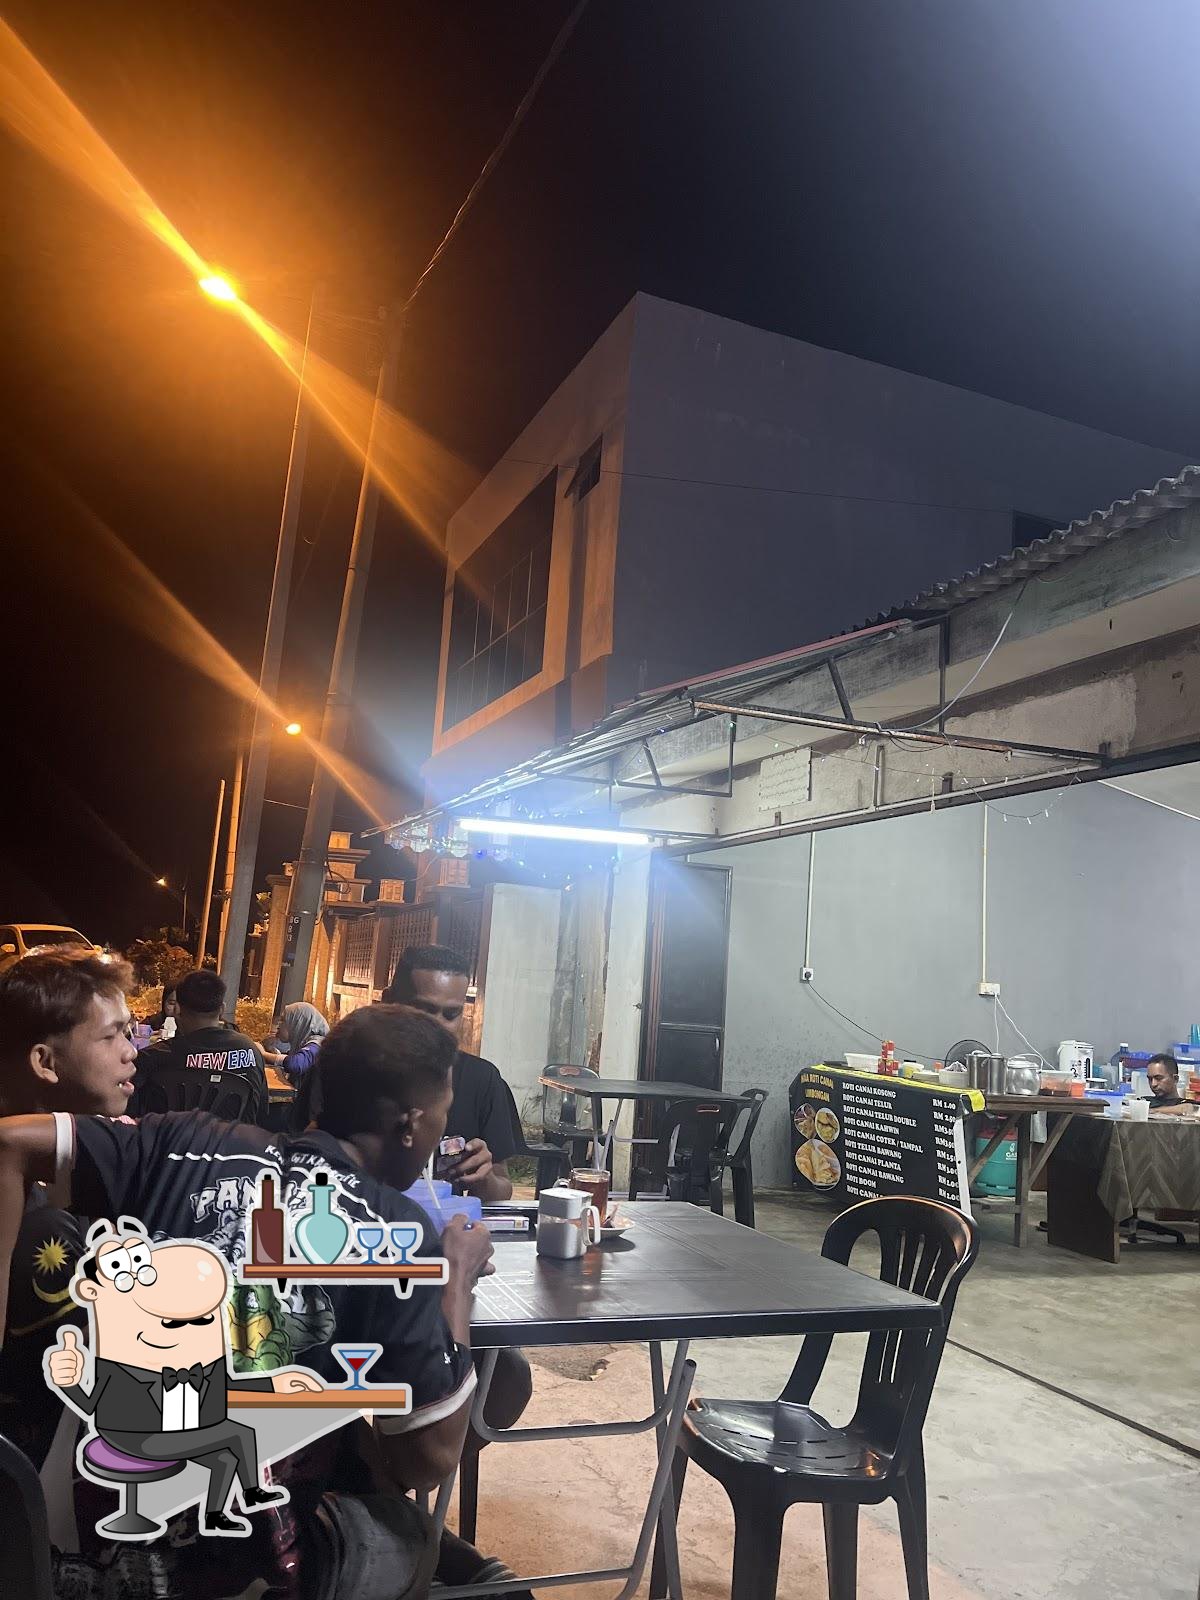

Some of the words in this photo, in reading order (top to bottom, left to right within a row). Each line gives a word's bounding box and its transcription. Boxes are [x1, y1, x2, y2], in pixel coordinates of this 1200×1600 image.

[186, 1052, 228, 1070] NEW
[228, 1049, 256, 1070] ERA
[842, 1082, 854, 1090] ROTI
[855, 1085, 872, 1094] CANAI
[873, 1088, 896, 1098] KOSONG
[843, 1094, 854, 1102] ROTI
[856, 1096, 873, 1106] CANAI
[874, 1100, 892, 1109] TELUR
[933, 1099, 942, 1107] RM
[843, 1105, 855, 1113] ROTI
[856, 1108, 874, 1117] CANAI
[874, 1112, 893, 1121] TELUR
[894, 1115, 916, 1127] DOUBLE
[934, 1112, 944, 1120] RM
[844, 1116, 855, 1125] ROTI
[856, 1120, 874, 1129] CANAI
[875, 1123, 899, 1135] KAHWIN
[844, 1128, 856, 1137] ROTI
[857, 1131, 875, 1141] CANAI
[900, 1141, 923, 1153] TAMPAL
[845, 1139, 856, 1148] ROTI
[857, 1143, 876, 1153] TELUR
[877, 1147, 902, 1159] BAWANG
[936, 1150, 946, 1159] RM
[846, 1151, 857, 1160] ROTI
[858, 1154, 877, 1165] CANAI
[878, 1159, 901, 1171] PLANTA
[937, 1162, 946, 1171] RM
[846, 1162, 857, 1171] ROTI
[859, 1166, 878, 1177] CANAI
[879, 1171, 904, 1183] BAWANG
[938, 1175, 946, 1184] RM
[846, 1174, 858, 1183] ROTI
[859, 1178, 876, 1188] BOOM
[847, 1185, 858, 1195] ROTI
[939, 1188, 946, 1198] RM
